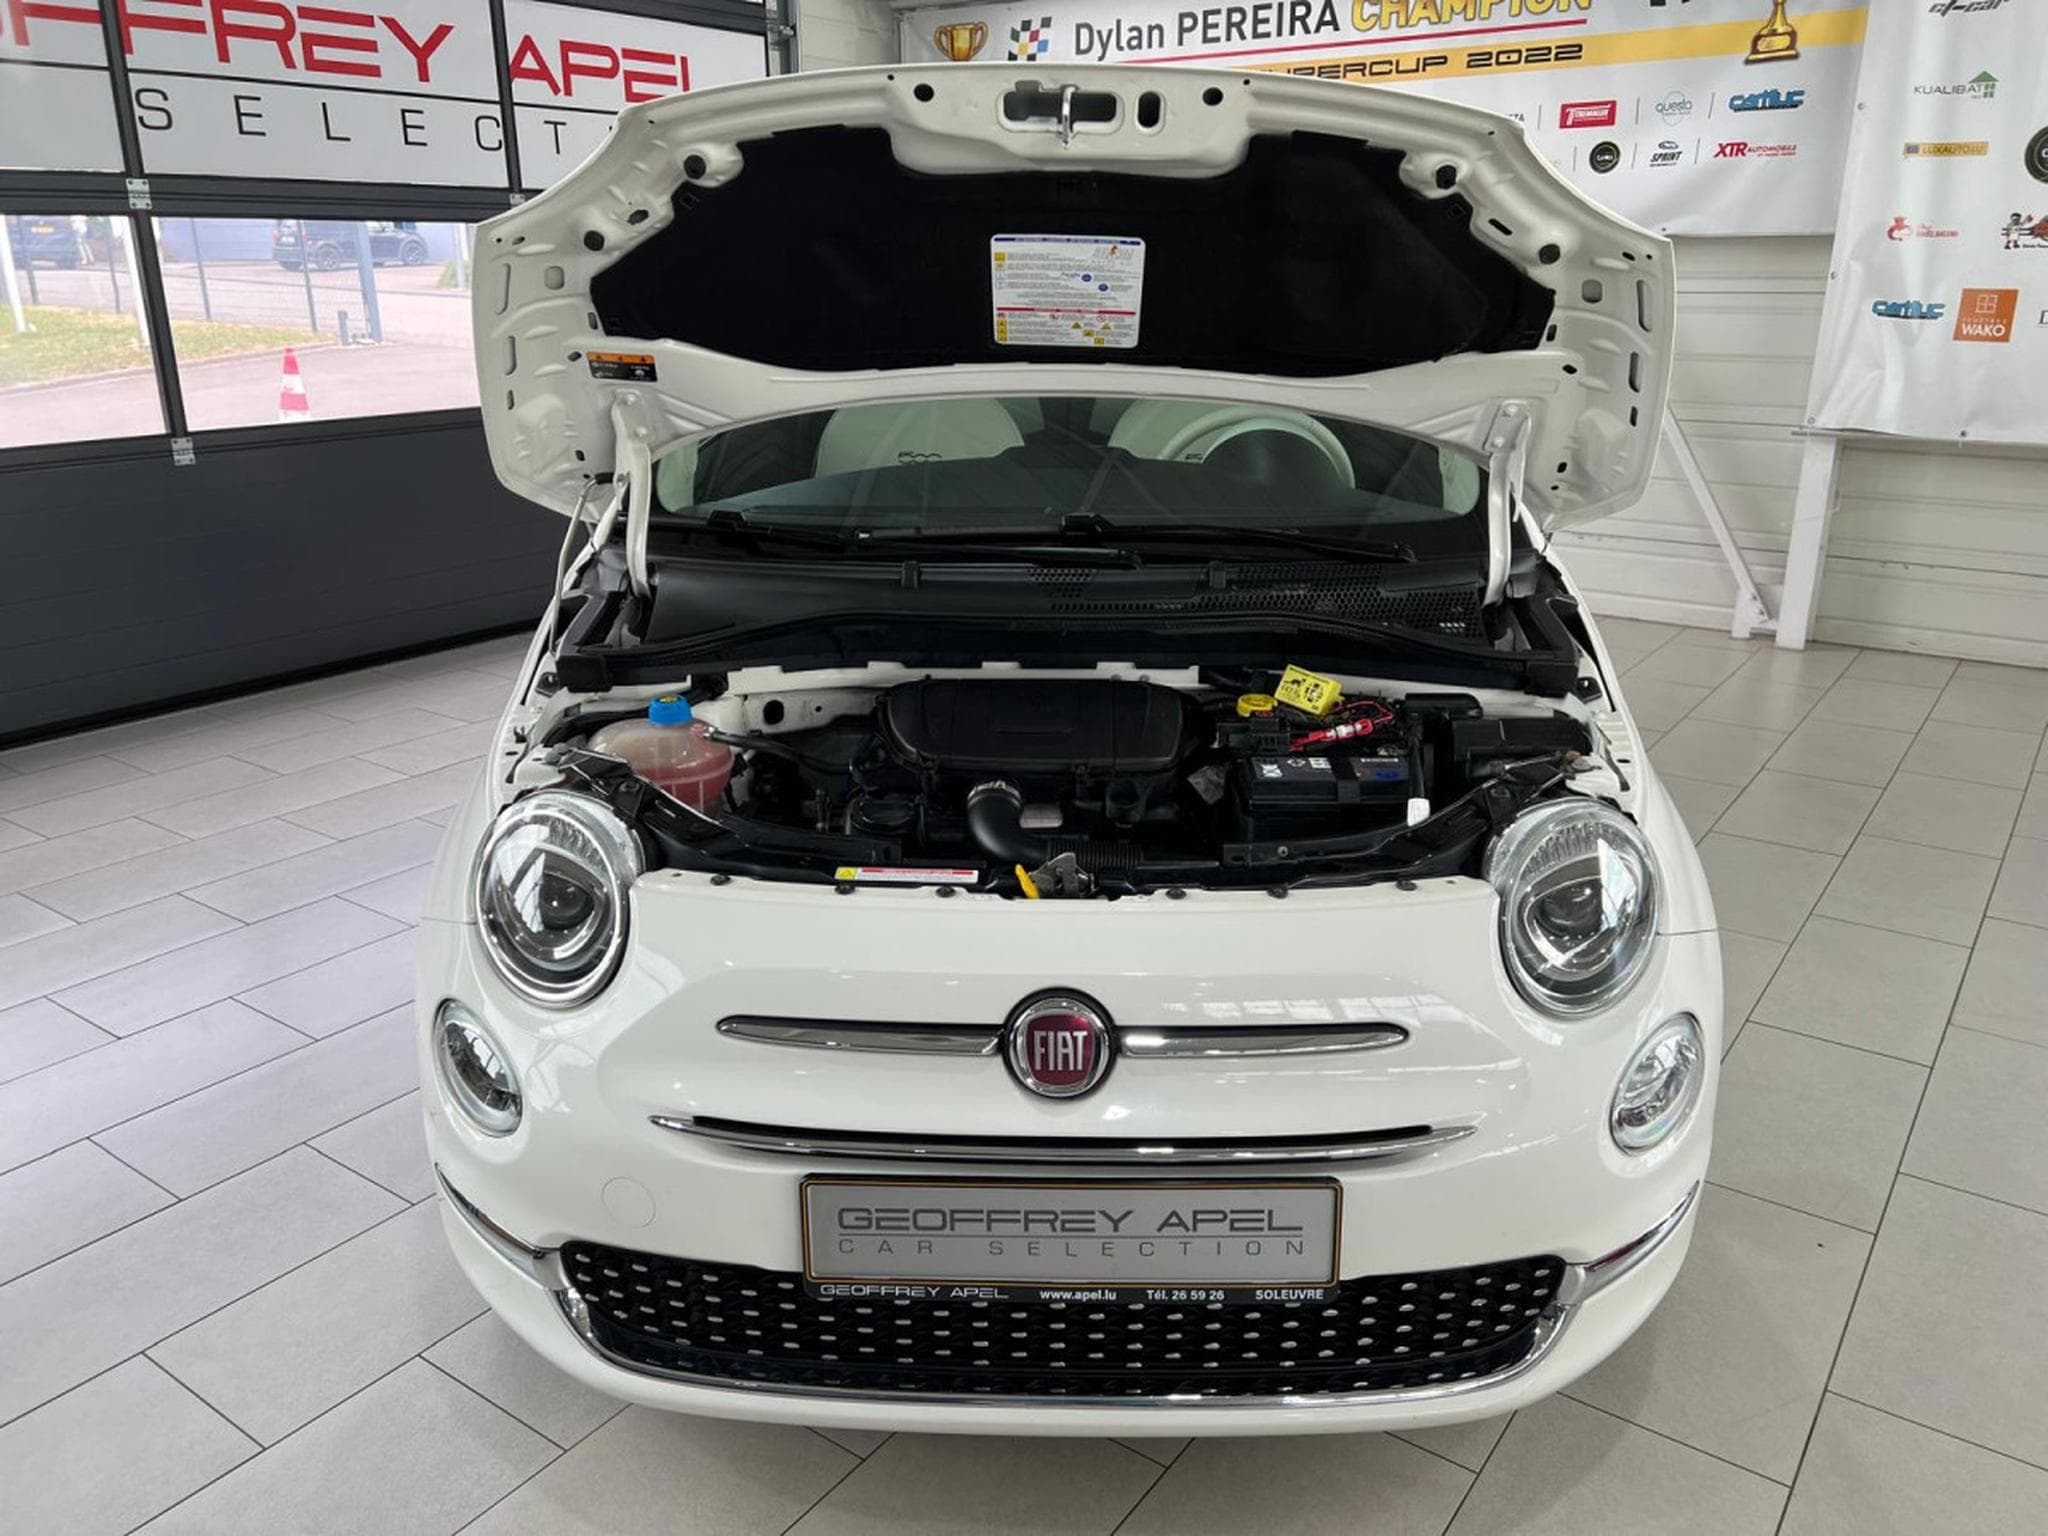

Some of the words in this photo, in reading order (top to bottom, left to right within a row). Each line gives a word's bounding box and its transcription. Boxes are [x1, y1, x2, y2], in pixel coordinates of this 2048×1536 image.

[0, 0, 455, 83] FFREY
[1075, 19, 1165, 62] Dylan
[1177, 0, 1341, 47] PEREIRA
[1351, 0, 1592, 32] CHAM
[1267, 54, 1448, 79] PERCUP
[1466, 43, 1584, 68] 2022
[134, 87, 613, 155] SELECT
[1651, 151, 1683, 163] SPRINT
[1714, 141, 1748, 158] XTR
[1961, 323, 2006, 337] WAKO
[1034, 1030, 1088, 1071] FIAT
[838, 1207, 1134, 1233] GEOFFREY
[1157, 1208, 1303, 1233] APEL
[838, 1238, 934, 1255] CAR
[988, 1239, 1303, 1257] SELECTION
[820, 1284, 941, 1298] GEOFFREY
[951, 1286, 1009, 1299] APEL
[1040, 1288, 1117, 1301] www.apel.lu
[1147, 1288, 1168, 1300] Tél.
[1172, 1289, 1187, 1300] 26
[1190, 1289, 1205, 1300] 59
[1209, 1289, 1225, 1300] 26
[1255, 1288, 1325, 1301] SOLEUVRE
